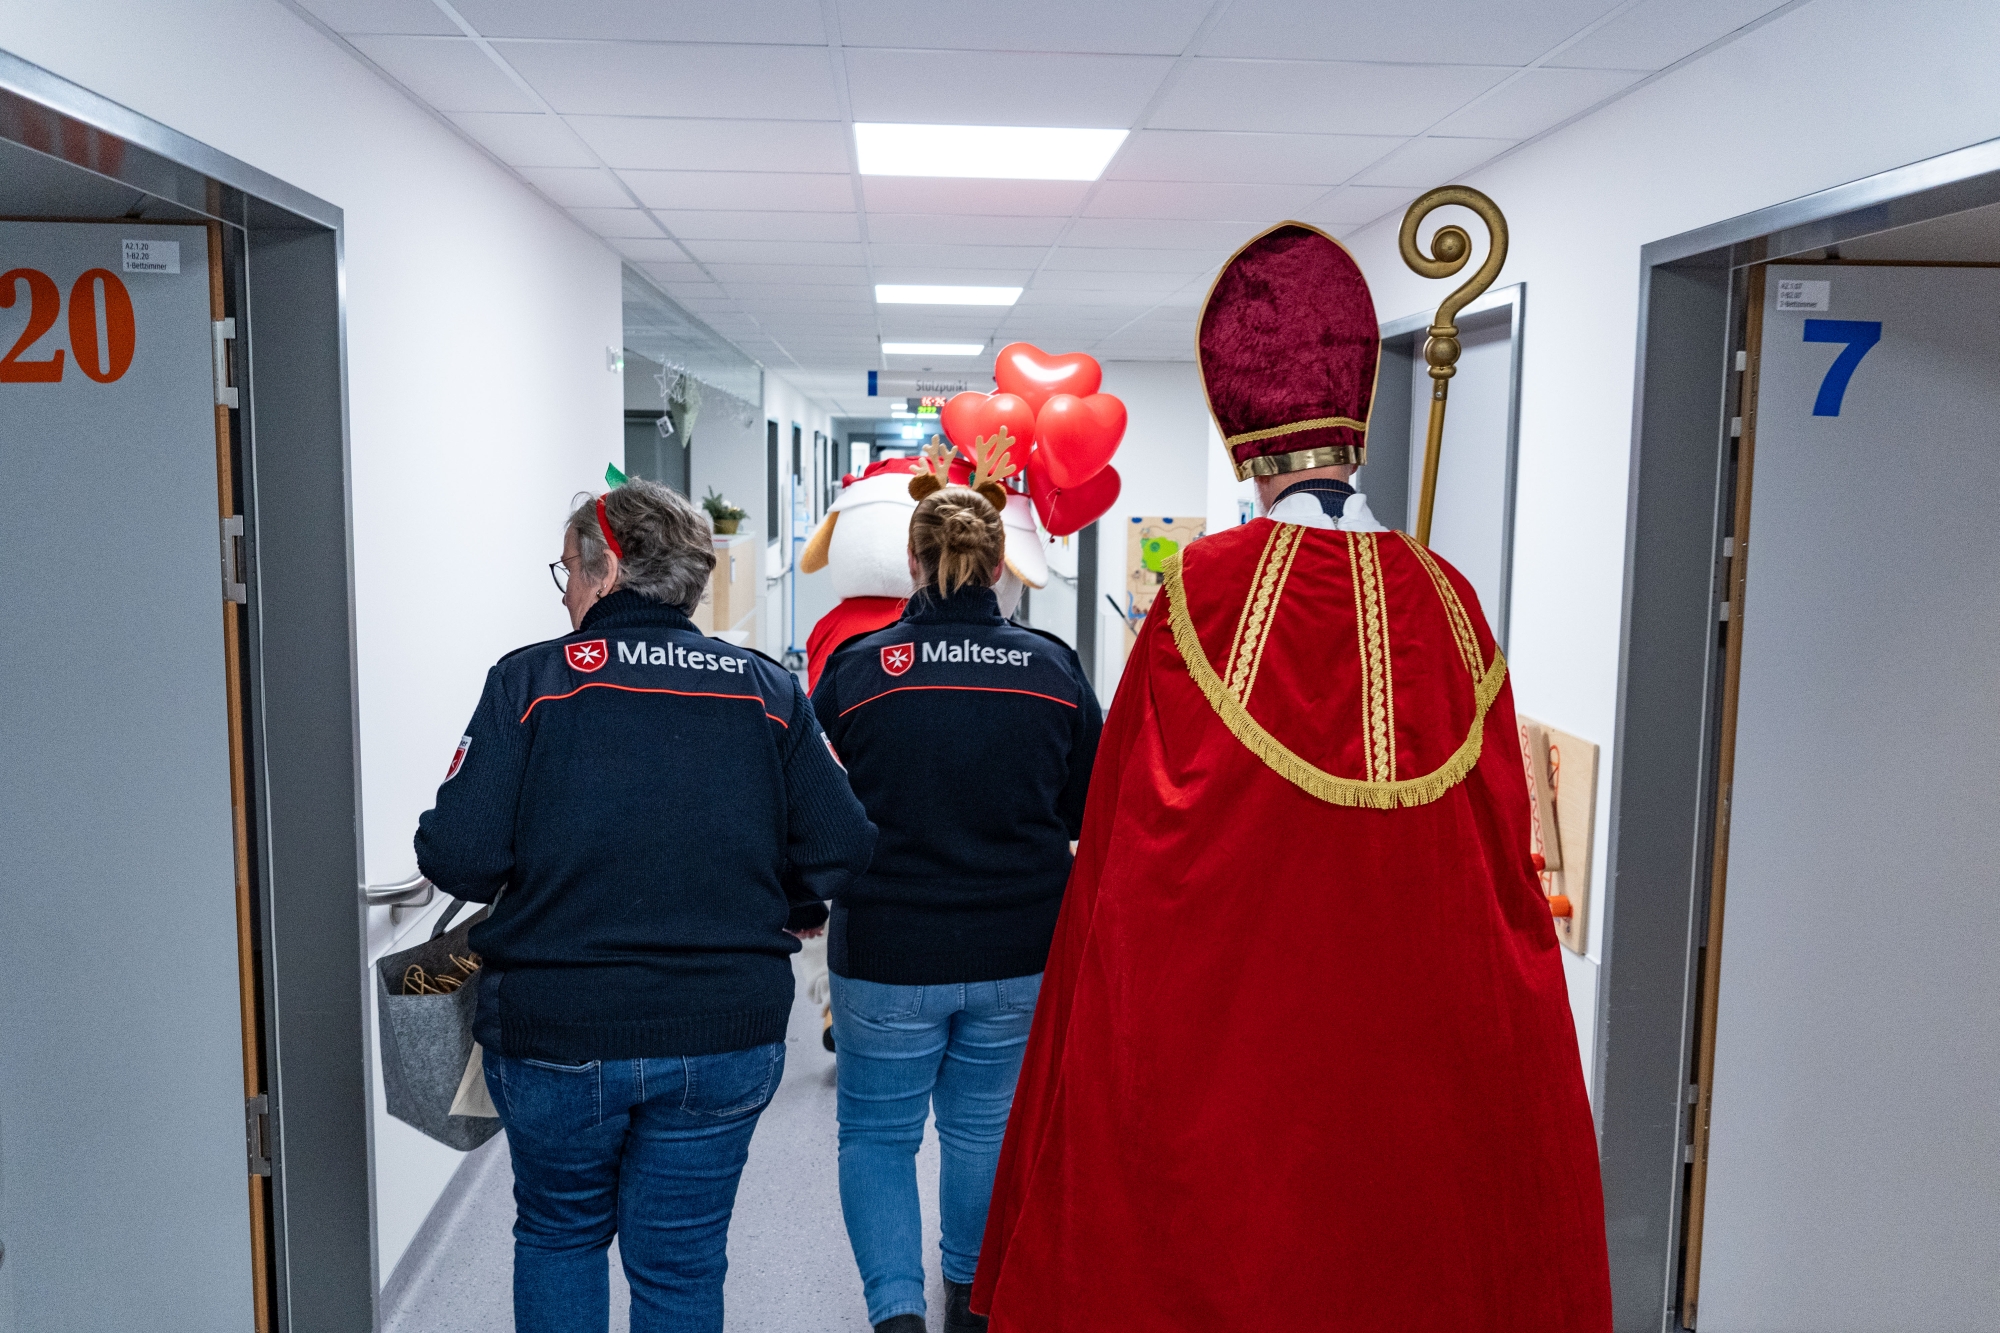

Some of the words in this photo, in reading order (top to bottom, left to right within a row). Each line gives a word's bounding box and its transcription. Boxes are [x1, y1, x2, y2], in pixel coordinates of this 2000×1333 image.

[0, 268, 136, 384] 20
[1802, 318, 1883, 417] 7
[617, 641, 748, 674] Malteser
[922, 639, 1033, 667] Malteser
